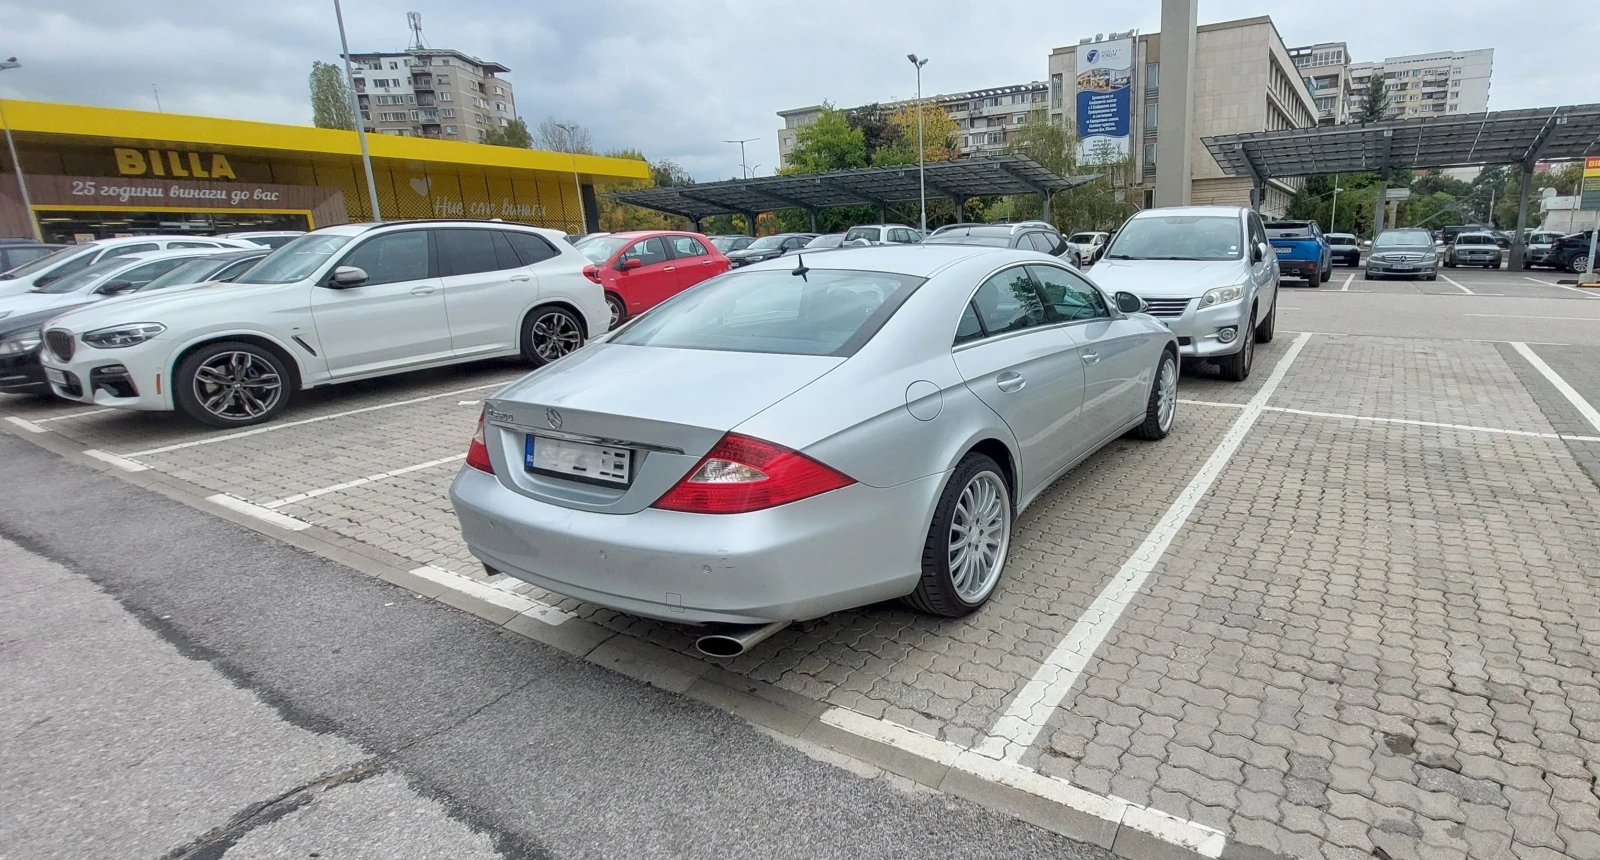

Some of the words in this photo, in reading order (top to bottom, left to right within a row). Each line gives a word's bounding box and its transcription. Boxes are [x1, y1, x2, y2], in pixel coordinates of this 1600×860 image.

[114, 147, 237, 179] BILLA
[72, 181, 95, 196] 25
[100, 186, 164, 202] години
[169, 186, 227, 201] винаги
[231, 188, 250, 205] до
[253, 188, 279, 202] вас
[433, 195, 464, 218] Ние
